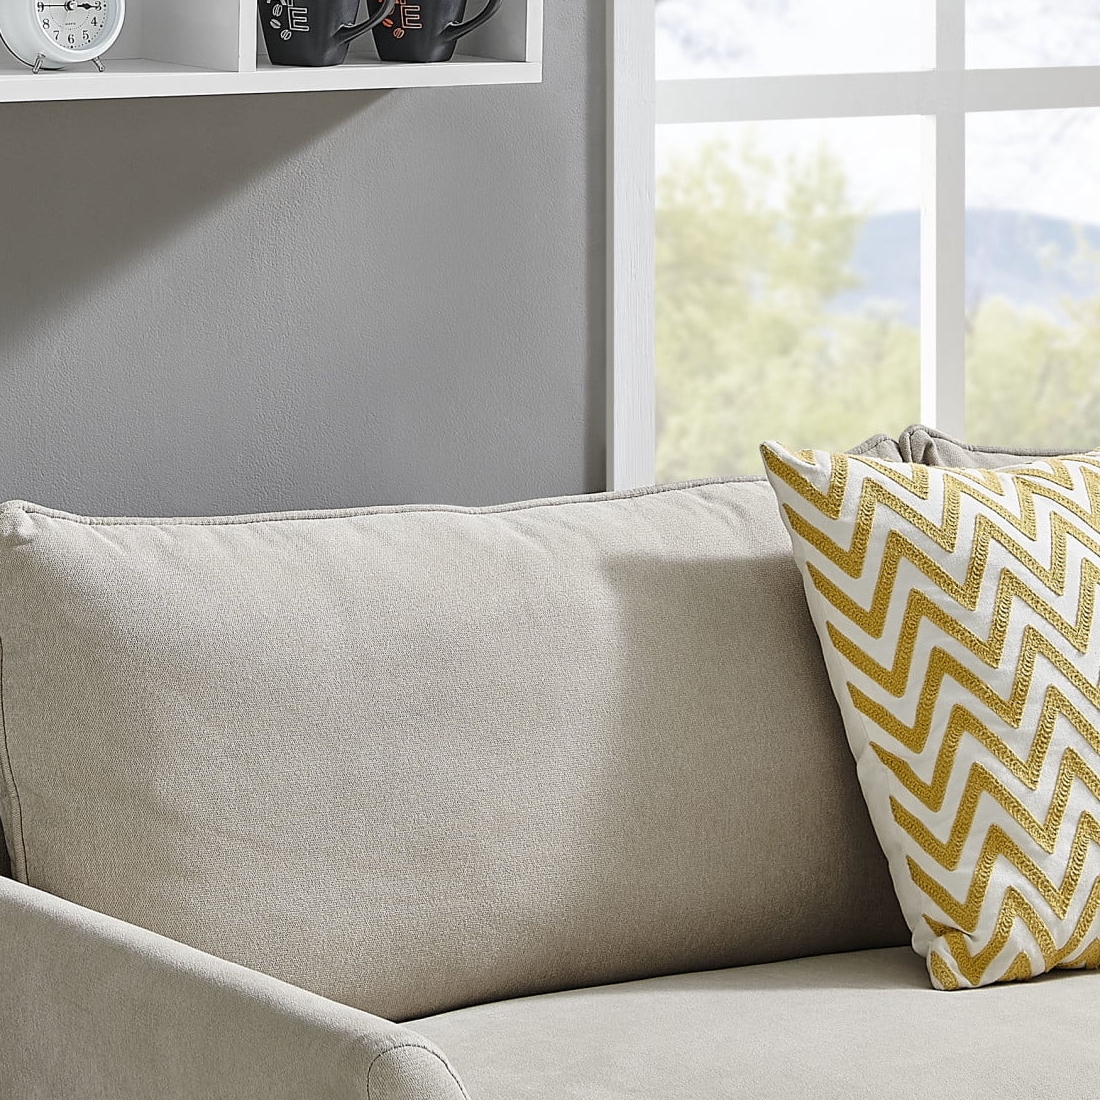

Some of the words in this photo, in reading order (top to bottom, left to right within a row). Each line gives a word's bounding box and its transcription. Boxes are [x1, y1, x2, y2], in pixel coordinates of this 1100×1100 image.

[37, 1, 44, 12] 9
[94, 1, 102, 11] 3
[42, 18, 50, 29] 8
[90, 16, 98, 26] 4
[53, 30, 60, 40] 7
[67, 34, 75, 44] 6
[82, 30, 89, 40] 5
